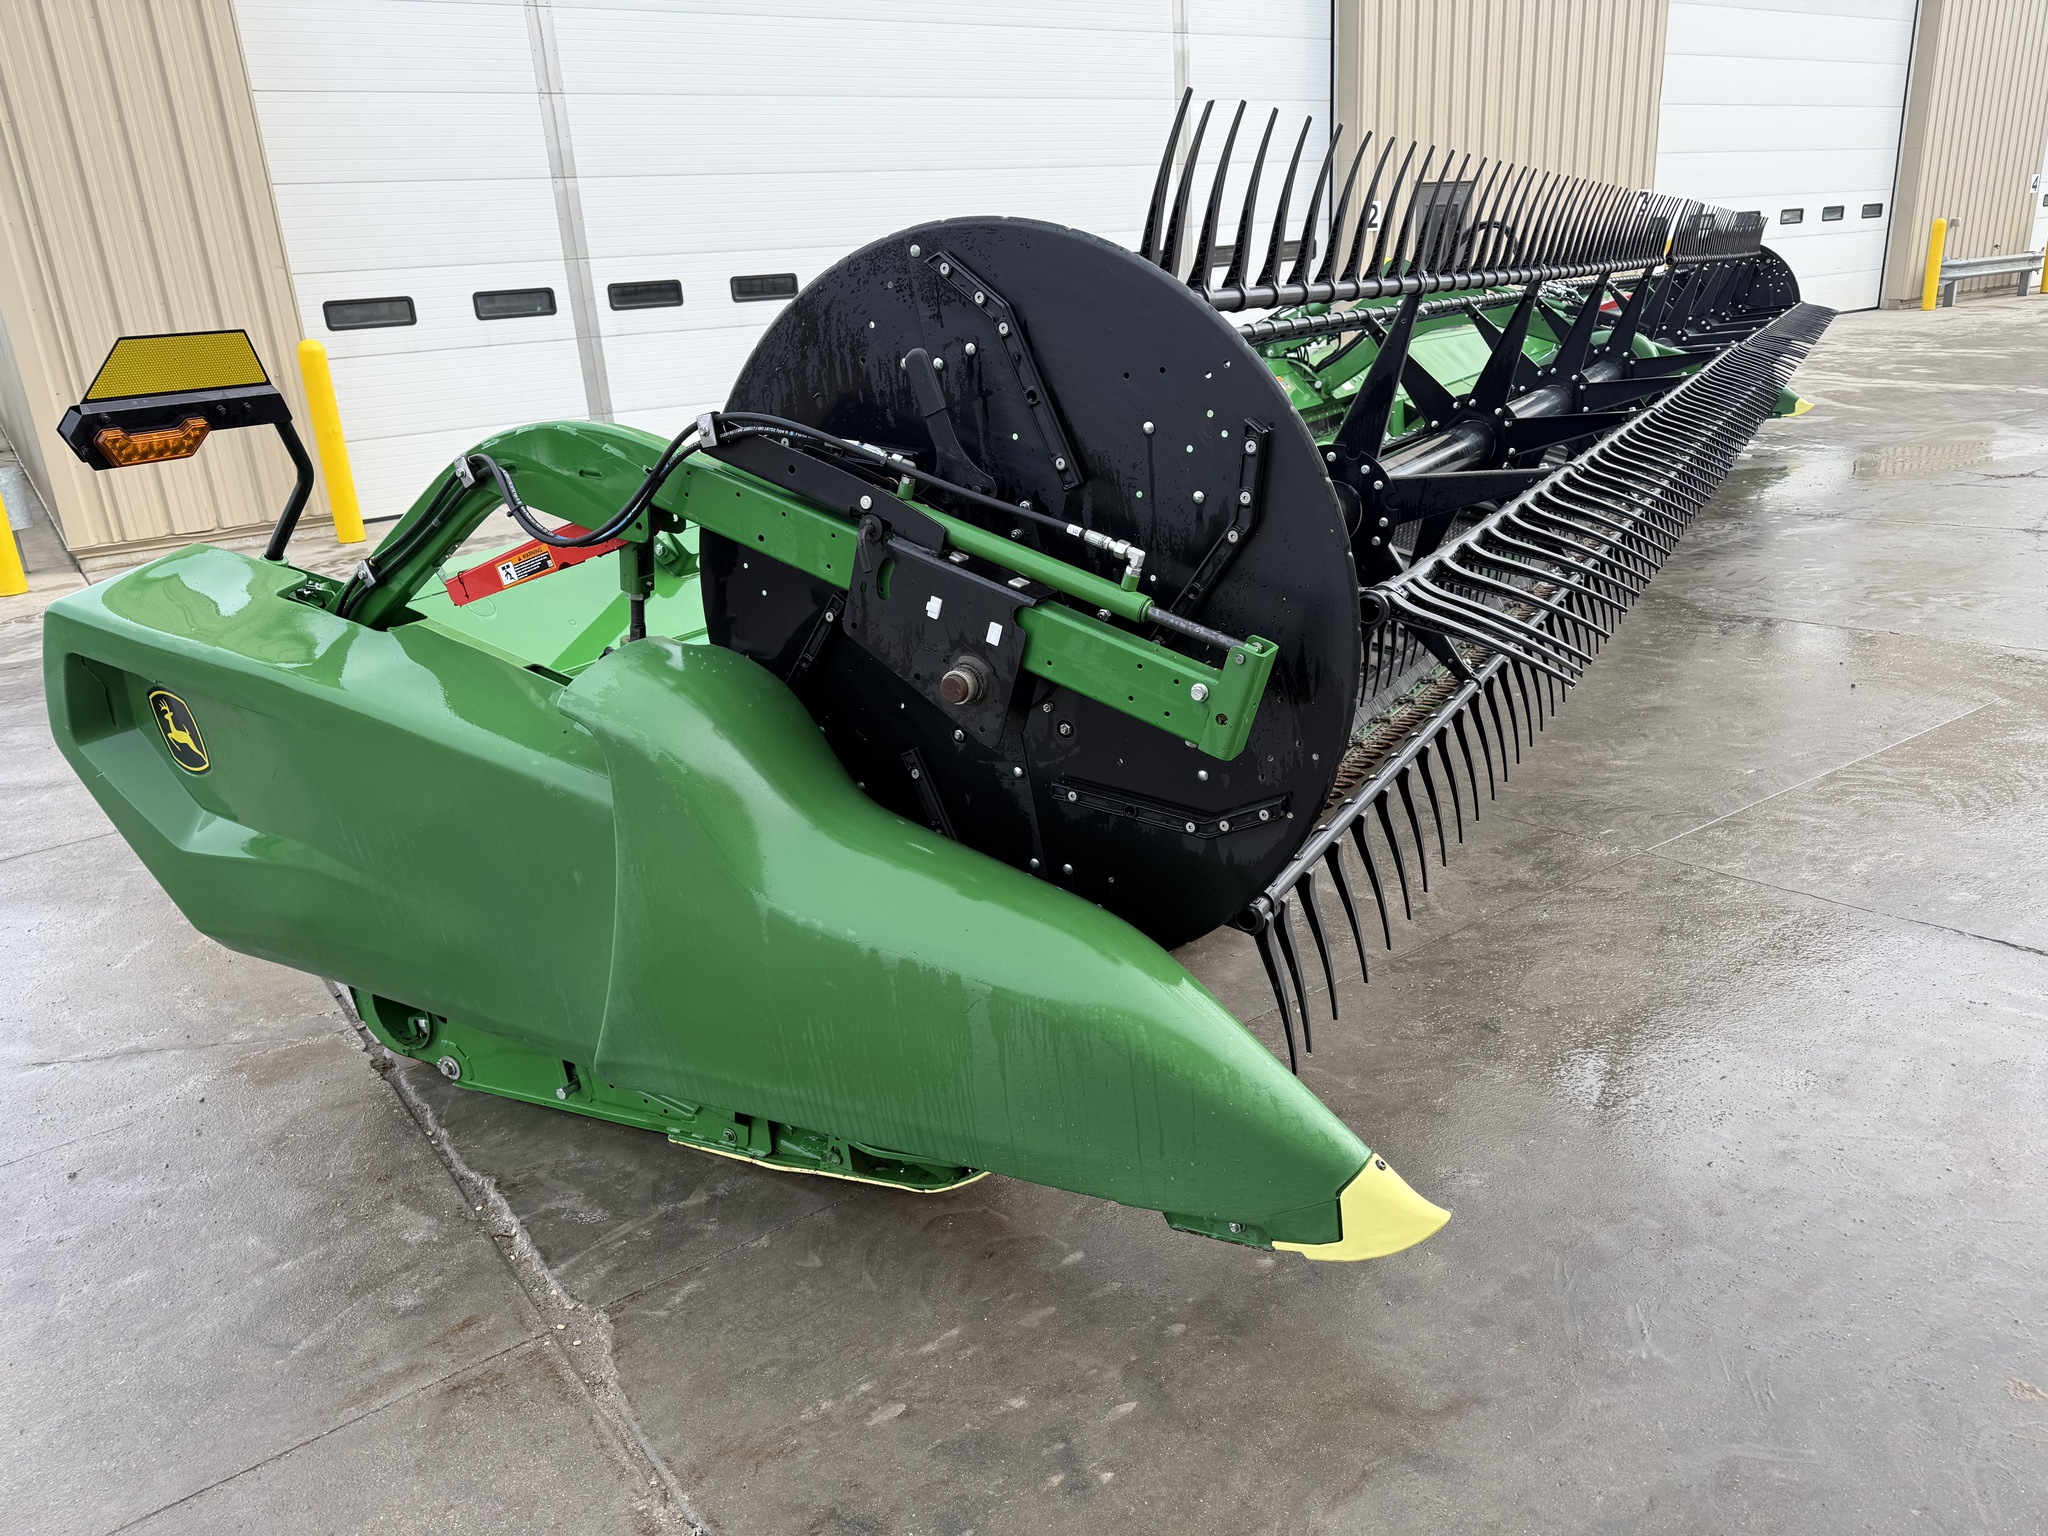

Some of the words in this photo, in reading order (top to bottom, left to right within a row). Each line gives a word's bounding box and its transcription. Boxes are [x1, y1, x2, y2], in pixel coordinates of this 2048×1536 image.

[2031, 175, 2039, 192] 4
[1367, 204, 1378, 228] 2
[522, 546, 543, 559] WARNING
